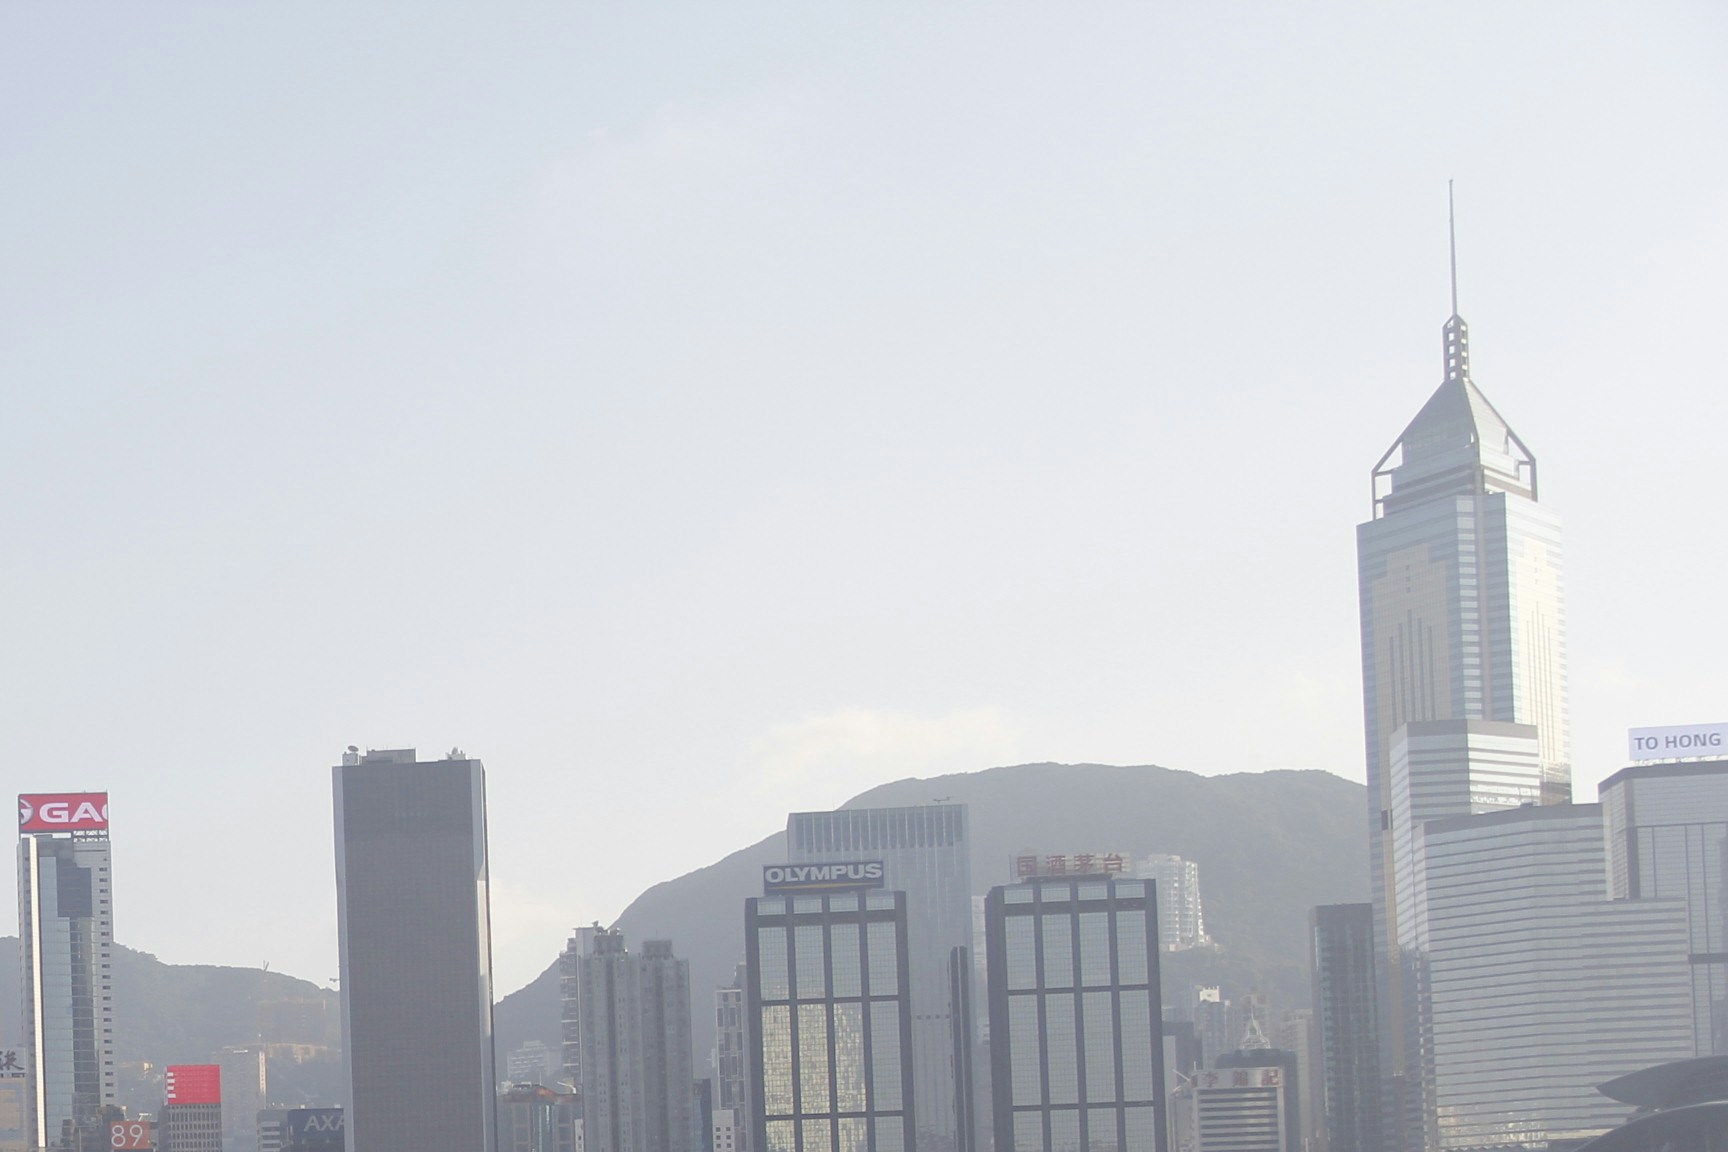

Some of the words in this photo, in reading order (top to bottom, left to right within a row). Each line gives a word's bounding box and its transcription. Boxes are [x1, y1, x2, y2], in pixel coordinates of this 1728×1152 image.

[1634, 736, 1658, 750] TO
[1665, 732, 1721, 748] HONG
[39, 802, 107, 823] GA
[765, 863, 882, 883] OLYMPUS
[110, 1124, 143, 1148] 89
